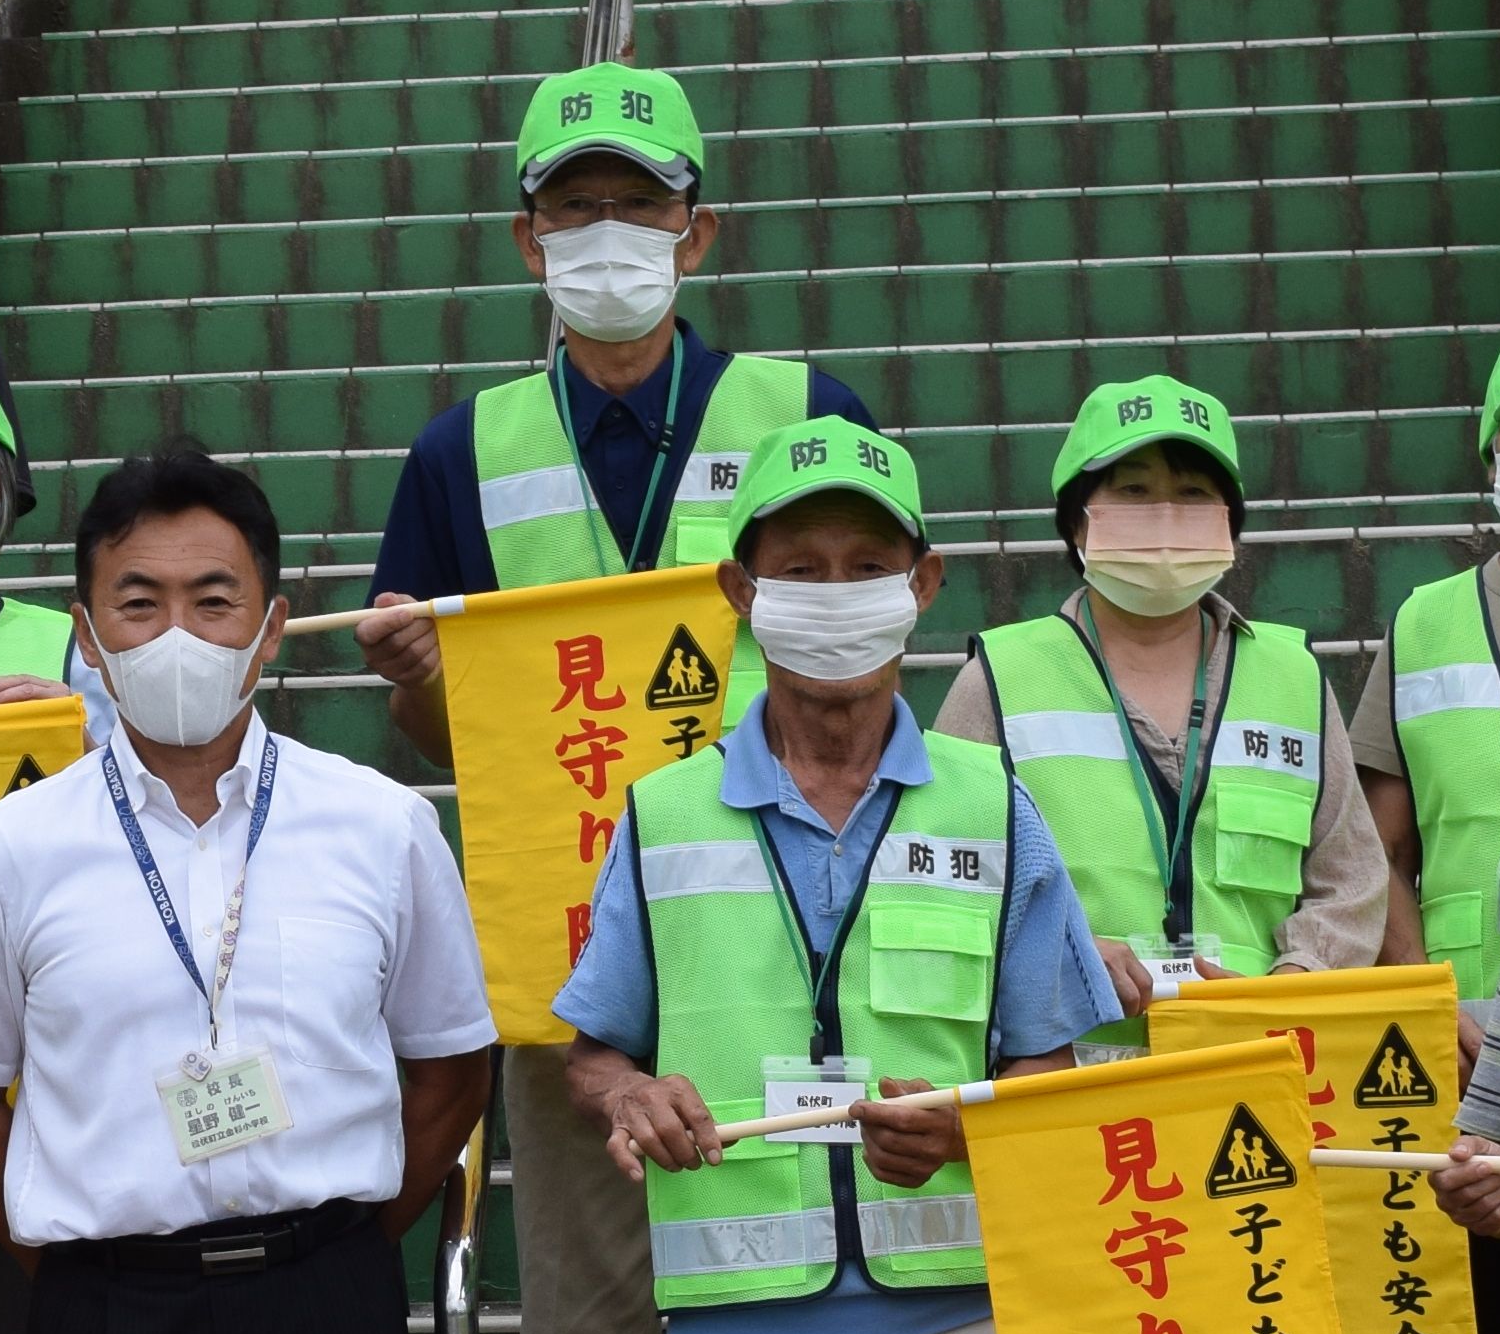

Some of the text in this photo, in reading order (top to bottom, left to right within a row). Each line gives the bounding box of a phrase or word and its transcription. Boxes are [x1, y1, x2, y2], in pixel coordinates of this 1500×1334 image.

[560, 89, 654, 127] 防犯
[1117, 395, 1210, 432] 防犯
[789, 438, 891, 478] 防犯
[1242, 729, 1304, 768] 防犯
[104, 757, 126, 802] KOBATON
[551, 634, 629, 969] 見守り
[908, 842, 981, 881] 防犯
[146, 869, 176, 927] KOBATON
[797, 1095, 833, 1107] 松伏町
